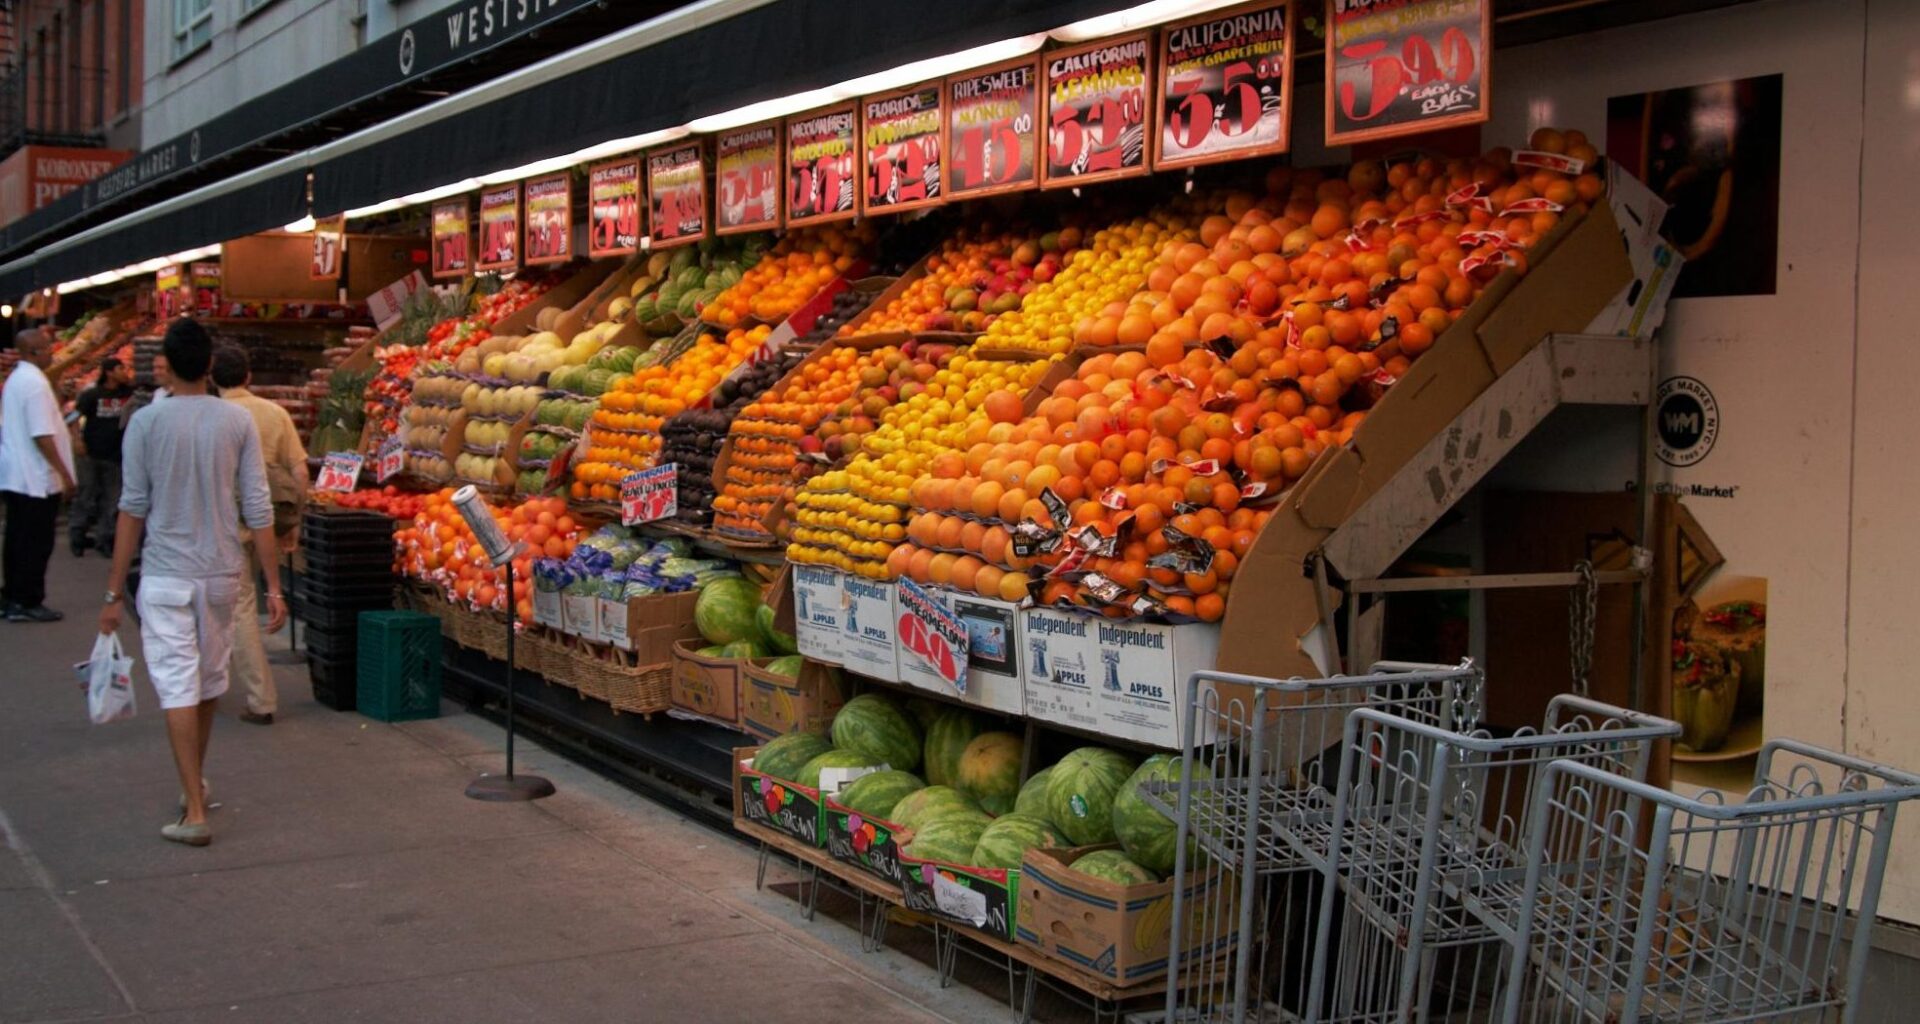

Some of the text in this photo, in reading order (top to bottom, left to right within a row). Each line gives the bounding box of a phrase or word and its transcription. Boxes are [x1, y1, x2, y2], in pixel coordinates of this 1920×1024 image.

[1169, 10, 1284, 52] CALIFORNIA
[1050, 40, 1146, 78] CALIFORNIA
[1056, 65, 1143, 104] LEMONS
[868, 95, 921, 119] FLORIDA
[140, 144, 177, 181] MARKET
[1664, 412, 1699, 434] WM
[1677, 381, 1716, 444] MARKET NYC
[813, 613, 836, 625] APPLES
[1027, 612, 1087, 638] Independent
[864, 626, 887, 640] APPLES
[1099, 622, 1165, 650] Independent
[1056, 669, 1086, 685] APPLES
[1130, 682, 1163, 698] APPLES
